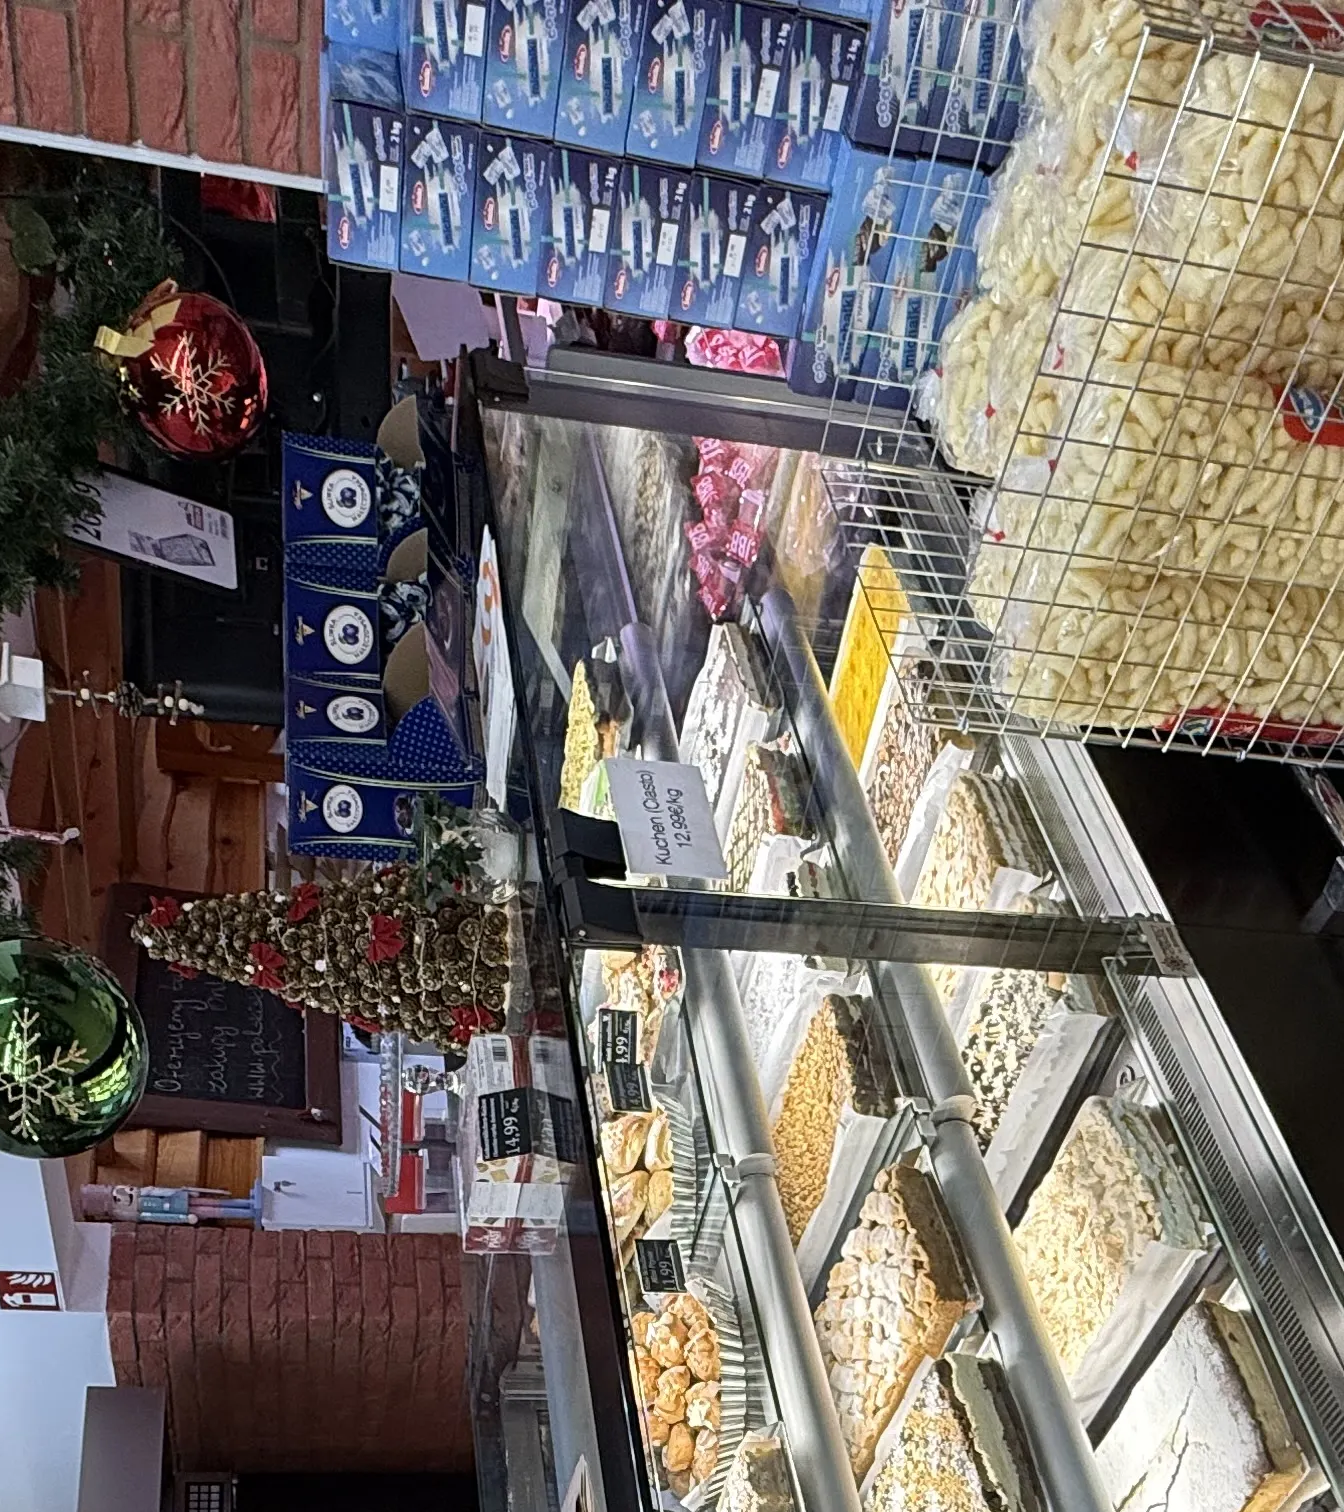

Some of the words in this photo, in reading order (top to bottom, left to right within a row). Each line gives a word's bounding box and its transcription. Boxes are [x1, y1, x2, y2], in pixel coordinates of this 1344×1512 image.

[778, 23, 790, 37] kg
[777, 38, 786, 46] 2
[848, 38, 861, 52] kg
[876, 81, 892, 128] COOL
[391, 121, 402, 134] kg
[390, 135, 399, 144] 2
[606, 167, 617, 180] kg
[605, 180, 614, 188] 2
[676, 182, 687, 194] kg
[745, 194, 756, 206] kg
[744, 206, 754, 214] 2
[812, 342, 827, 383] COOL
[700, 439, 724, 459] JB
[71, 480, 107, 541] 26,9
[635, 770, 664, 813] (Ciasto)
[665, 788, 692, 848] 12,99€/kg
[649, 816, 672, 865] Kuchen
[503, 1116, 520, 1154] 14,99
